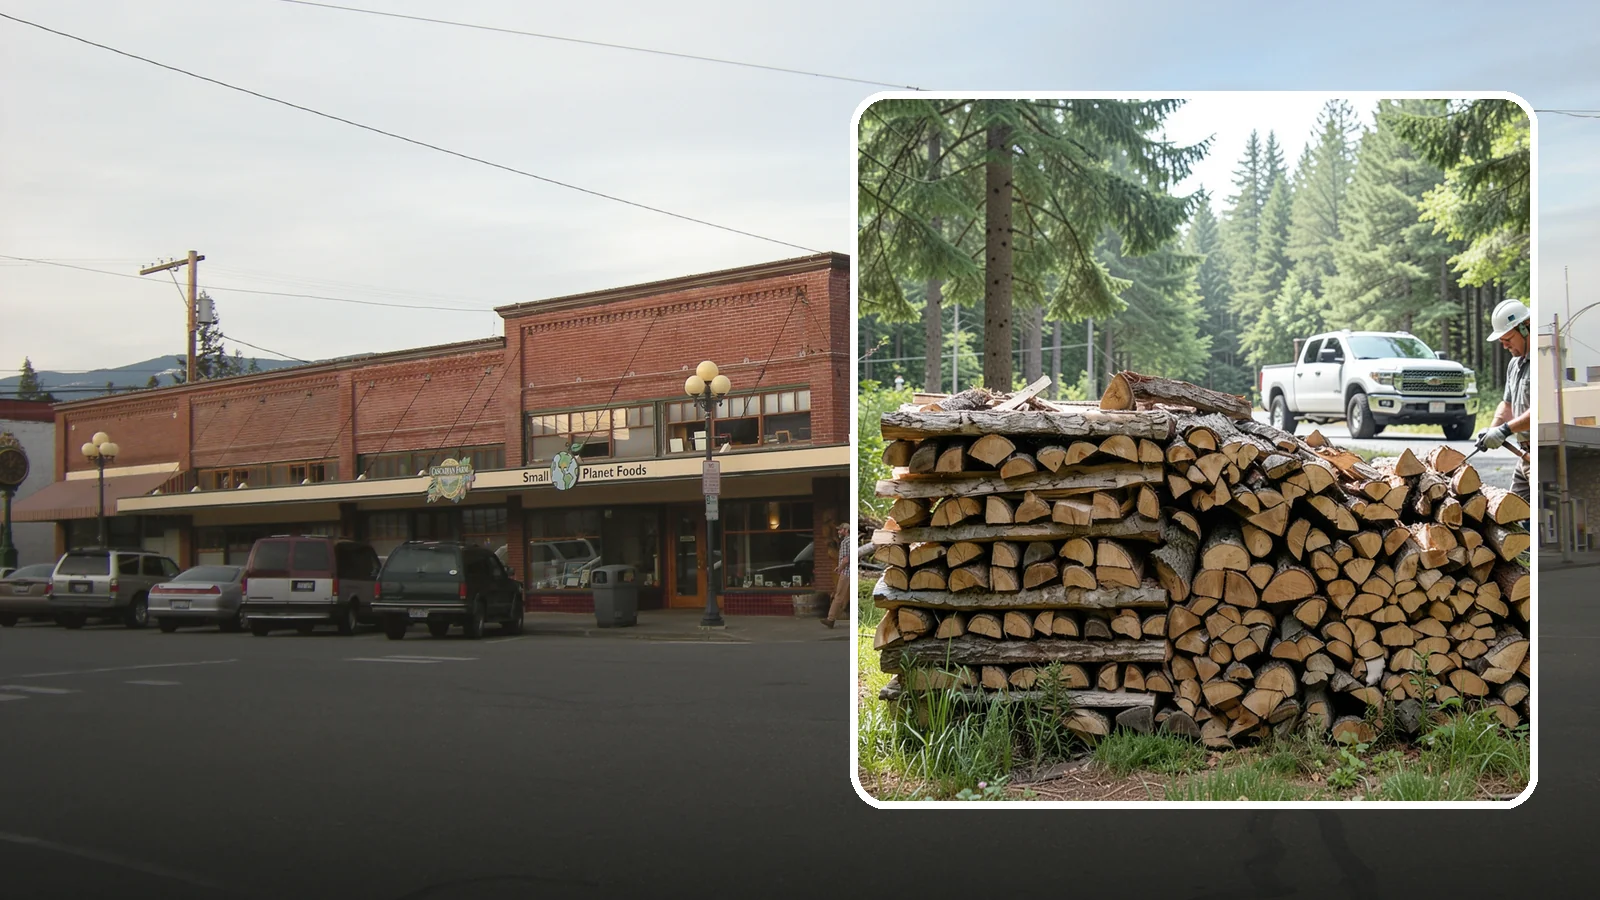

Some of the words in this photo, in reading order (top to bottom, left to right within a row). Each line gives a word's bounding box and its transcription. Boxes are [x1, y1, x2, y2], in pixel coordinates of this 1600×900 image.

[523, 471, 549, 483] Small
[582, 467, 614, 479] Planet
[617, 464, 647, 477] Foods
